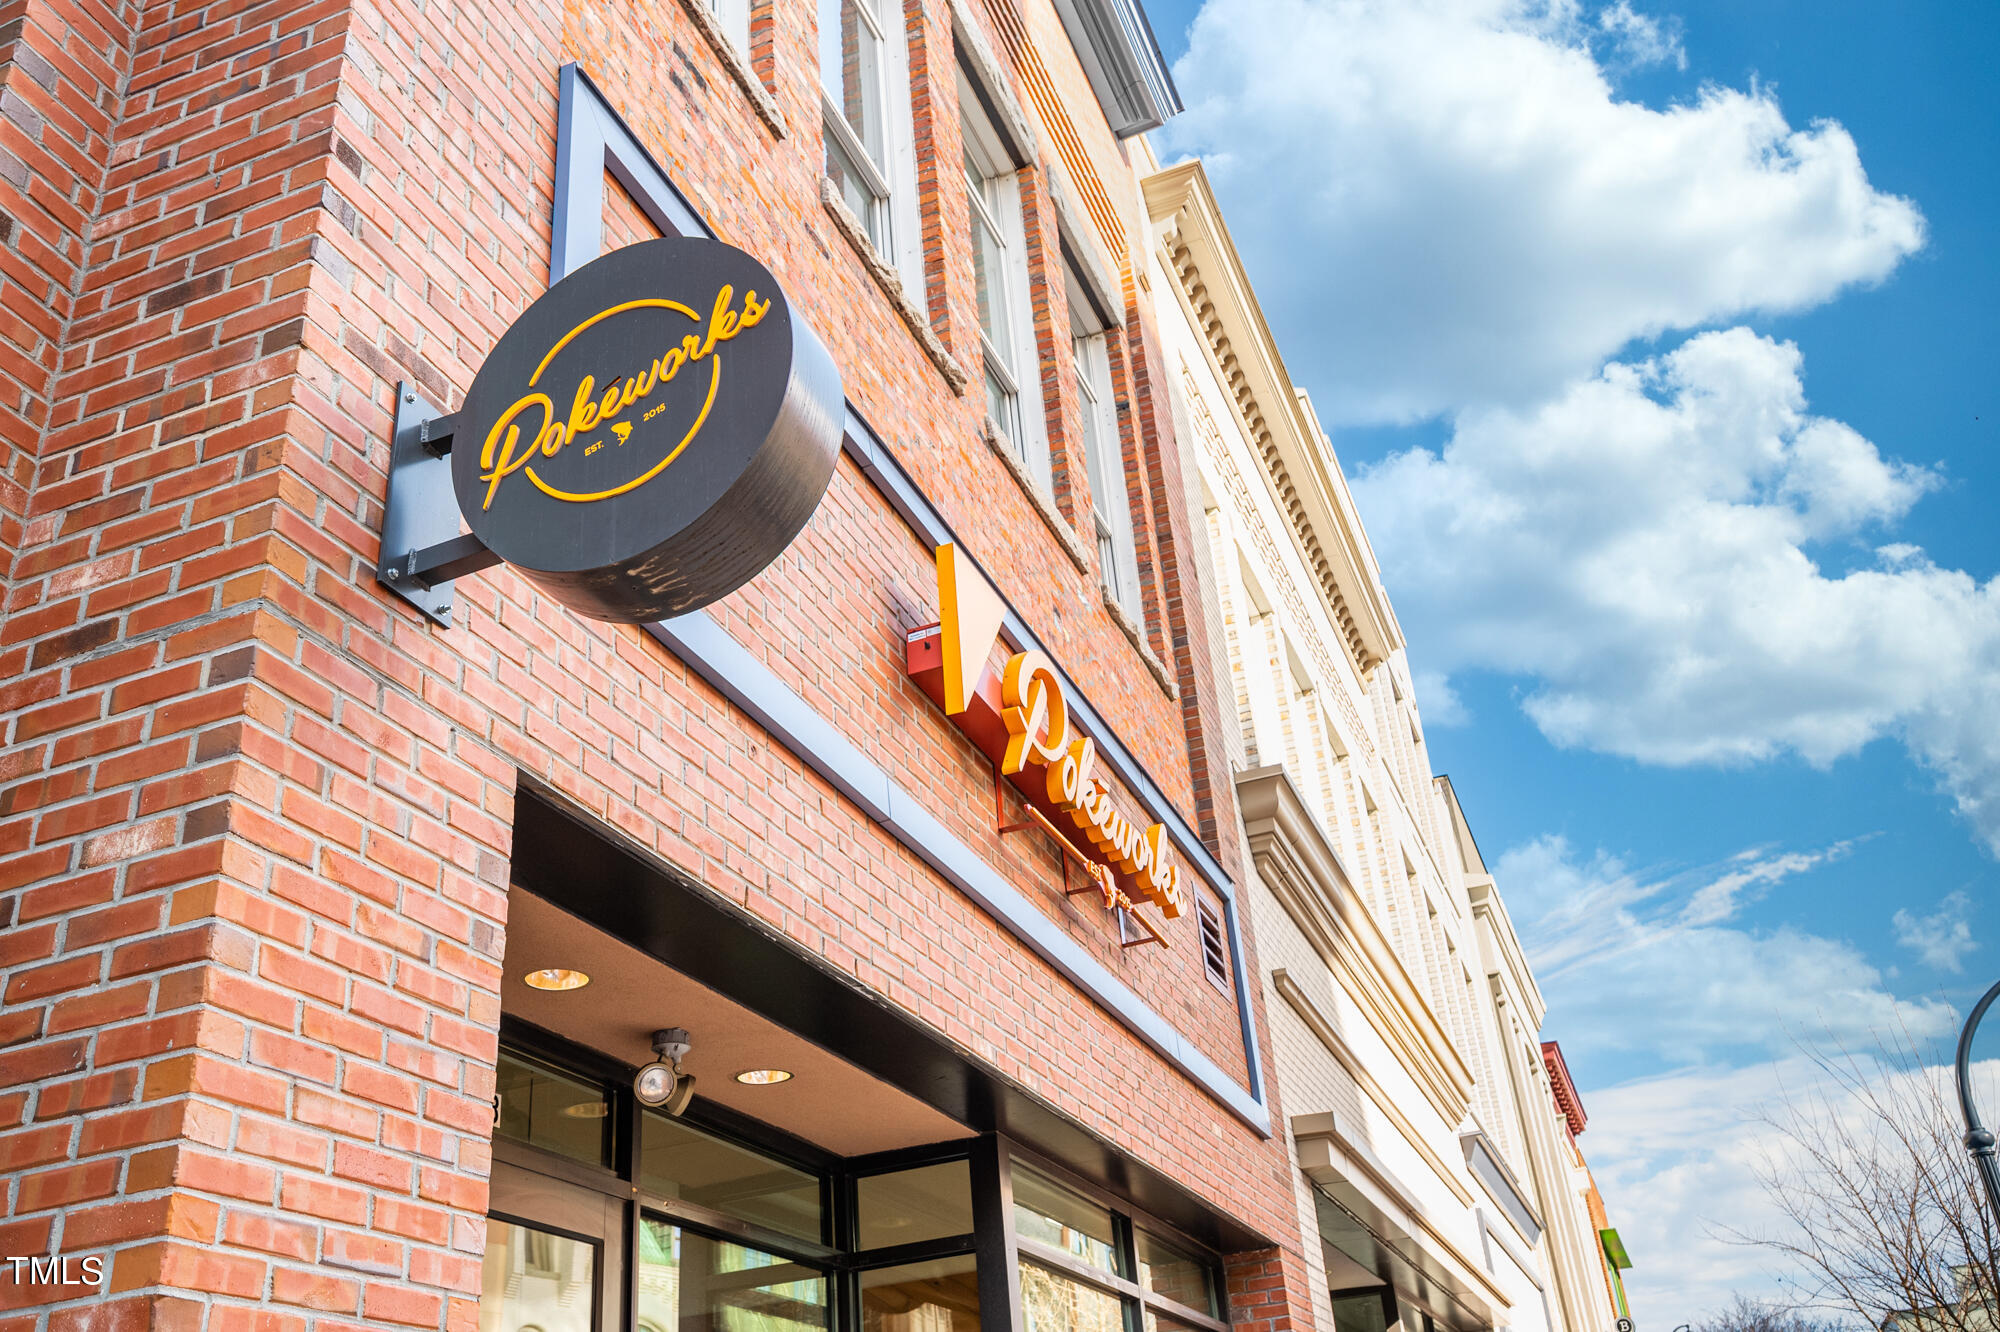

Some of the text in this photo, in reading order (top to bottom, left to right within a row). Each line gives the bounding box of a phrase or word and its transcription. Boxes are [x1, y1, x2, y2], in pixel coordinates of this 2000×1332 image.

[584, 402, 666, 456] EST. 2015
[1619, 1320, 1630, 1332] B
